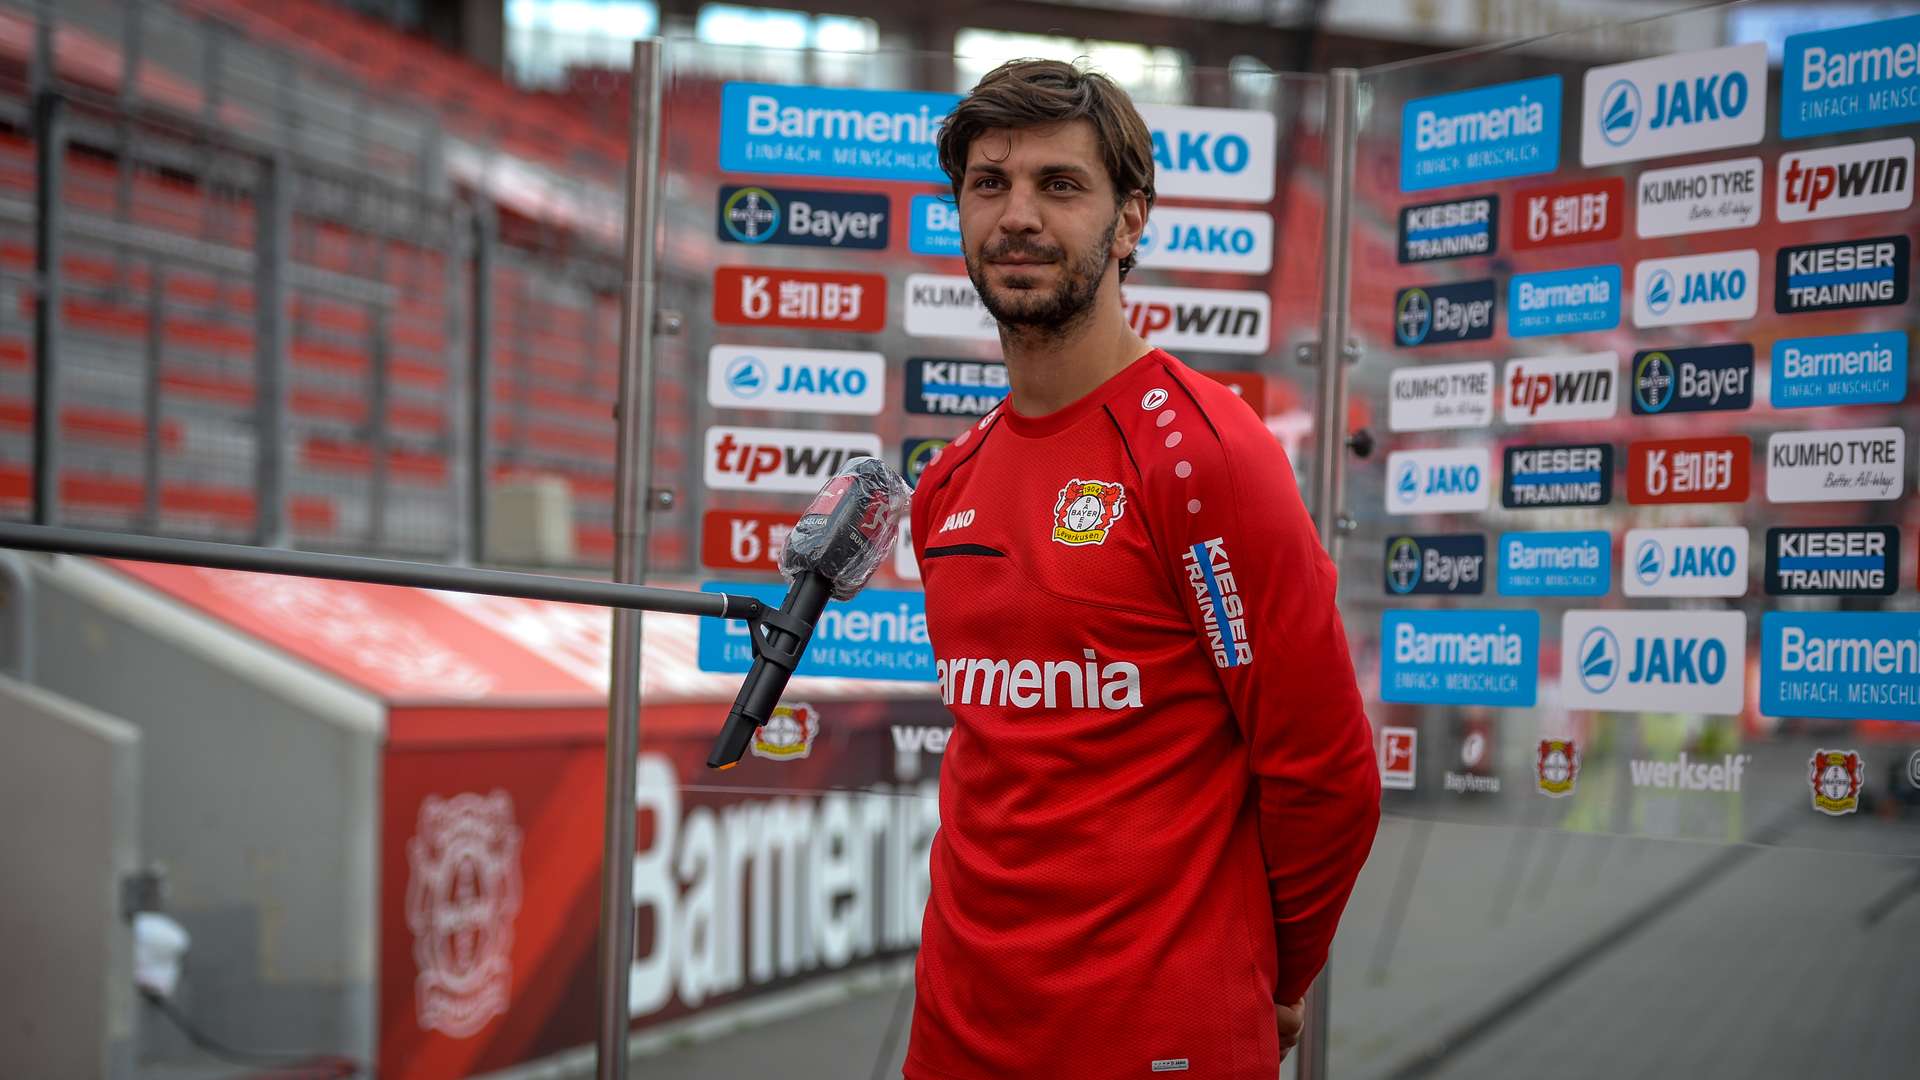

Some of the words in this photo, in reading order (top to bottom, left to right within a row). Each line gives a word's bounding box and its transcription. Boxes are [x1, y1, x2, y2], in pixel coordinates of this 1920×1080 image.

[1802, 41, 1920, 92] Barme
[1649, 71, 1747, 129] JAKO
[1869, 85, 1920, 112] MENSC
[1416, 94, 1543, 152] Barmenia
[833, 148, 940, 169] MENSCHLIC
[1152, 131, 1250, 175] AKO
[1643, 175, 1707, 204] KUMHO
[1710, 170, 1755, 196] TYRE
[788, 201, 883, 245] Bayer
[1407, 200, 1490, 231] KIESER
[1167, 224, 1255, 255] JAKO
[1407, 232, 1489, 260] TRAINING
[1788, 243, 1895, 276] KIESER
[1518, 276, 1611, 311] Barmenia
[1680, 269, 1747, 305] JAKO
[1787, 280, 1894, 307] TRAINING
[1123, 302, 1261, 338] ipwin
[1433, 297, 1493, 338] Bayer
[922, 361, 1009, 387] KIES
[1784, 342, 1893, 378] Barmenia
[776, 364, 869, 396] JAKO
[1394, 374, 1448, 400] KUMHO
[1451, 372, 1488, 396] TYRE
[1680, 362, 1749, 405] Bayer
[1511, 448, 1602, 475] KIESER
[1773, 441, 1843, 469] KUMHO
[1847, 439, 1896, 465] TYRE
[1083, 486, 1101, 494] 1904
[1425, 463, 1480, 496] JAKO
[1511, 482, 1601, 505] TRAINING
[939, 508, 976, 534] JAKO
[1070, 509, 1098, 518] BAYER
[1056, 530, 1100, 541] Leverkusen
[1777, 532, 1886, 558] KIESER
[1423, 549, 1483, 591] Bayer
[1508, 540, 1600, 571] Barmenia
[1670, 546, 1737, 577] JAKO
[1777, 569, 1886, 590] TRAINING
[1181, 545, 1230, 668] TRAINING
[1204, 536, 1254, 666] KIESER
[1395, 622, 1522, 666] Barmenia
[1781, 626, 1920, 674] Barmen
[1628, 637, 1727, 686] JAKO
[936, 649, 1144, 710] armenia
[1849, 683, 1920, 705] MENSCHL
[1630, 753, 1745, 792] werkself
